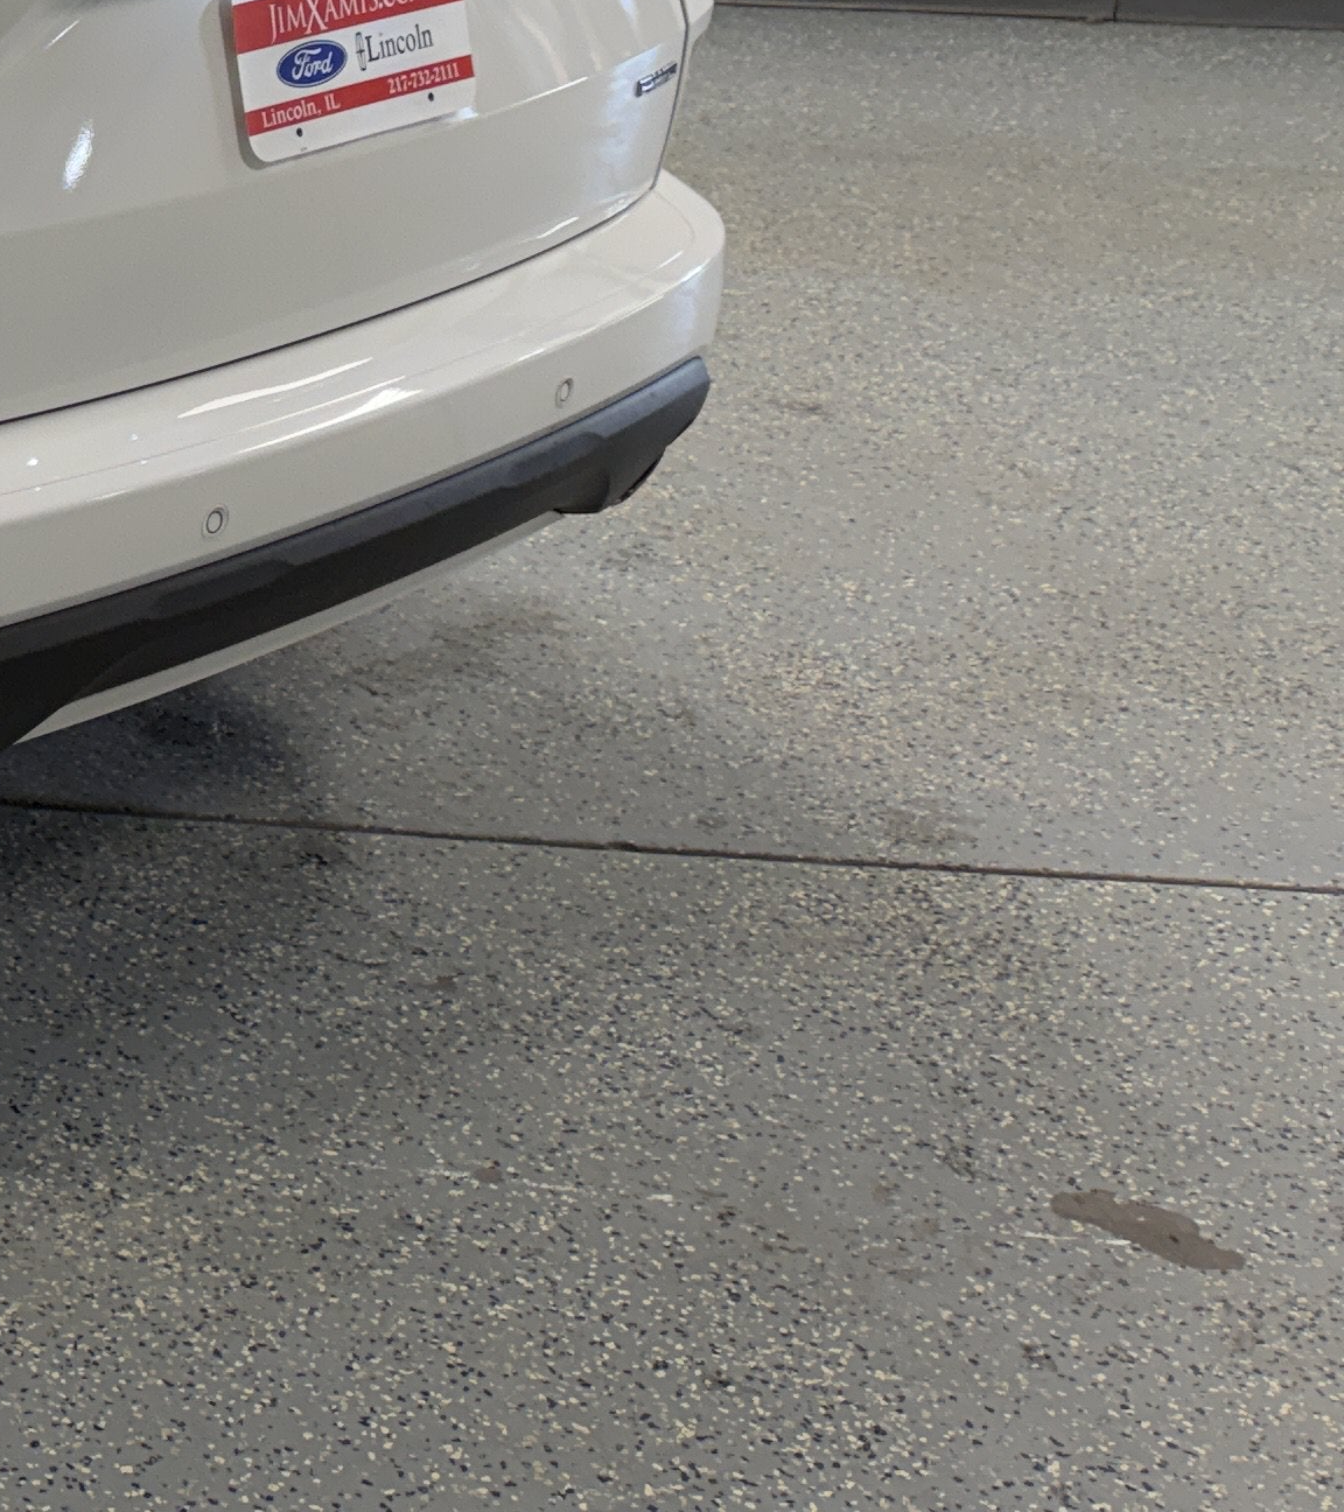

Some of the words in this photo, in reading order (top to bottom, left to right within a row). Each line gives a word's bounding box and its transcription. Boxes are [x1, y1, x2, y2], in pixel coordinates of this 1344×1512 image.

[364, 24, 434, 63] Lincoln
[291, 47, 334, 81] Ford
[262, 97, 322, 129] Lincoln,
[324, 92, 342, 111] IL
